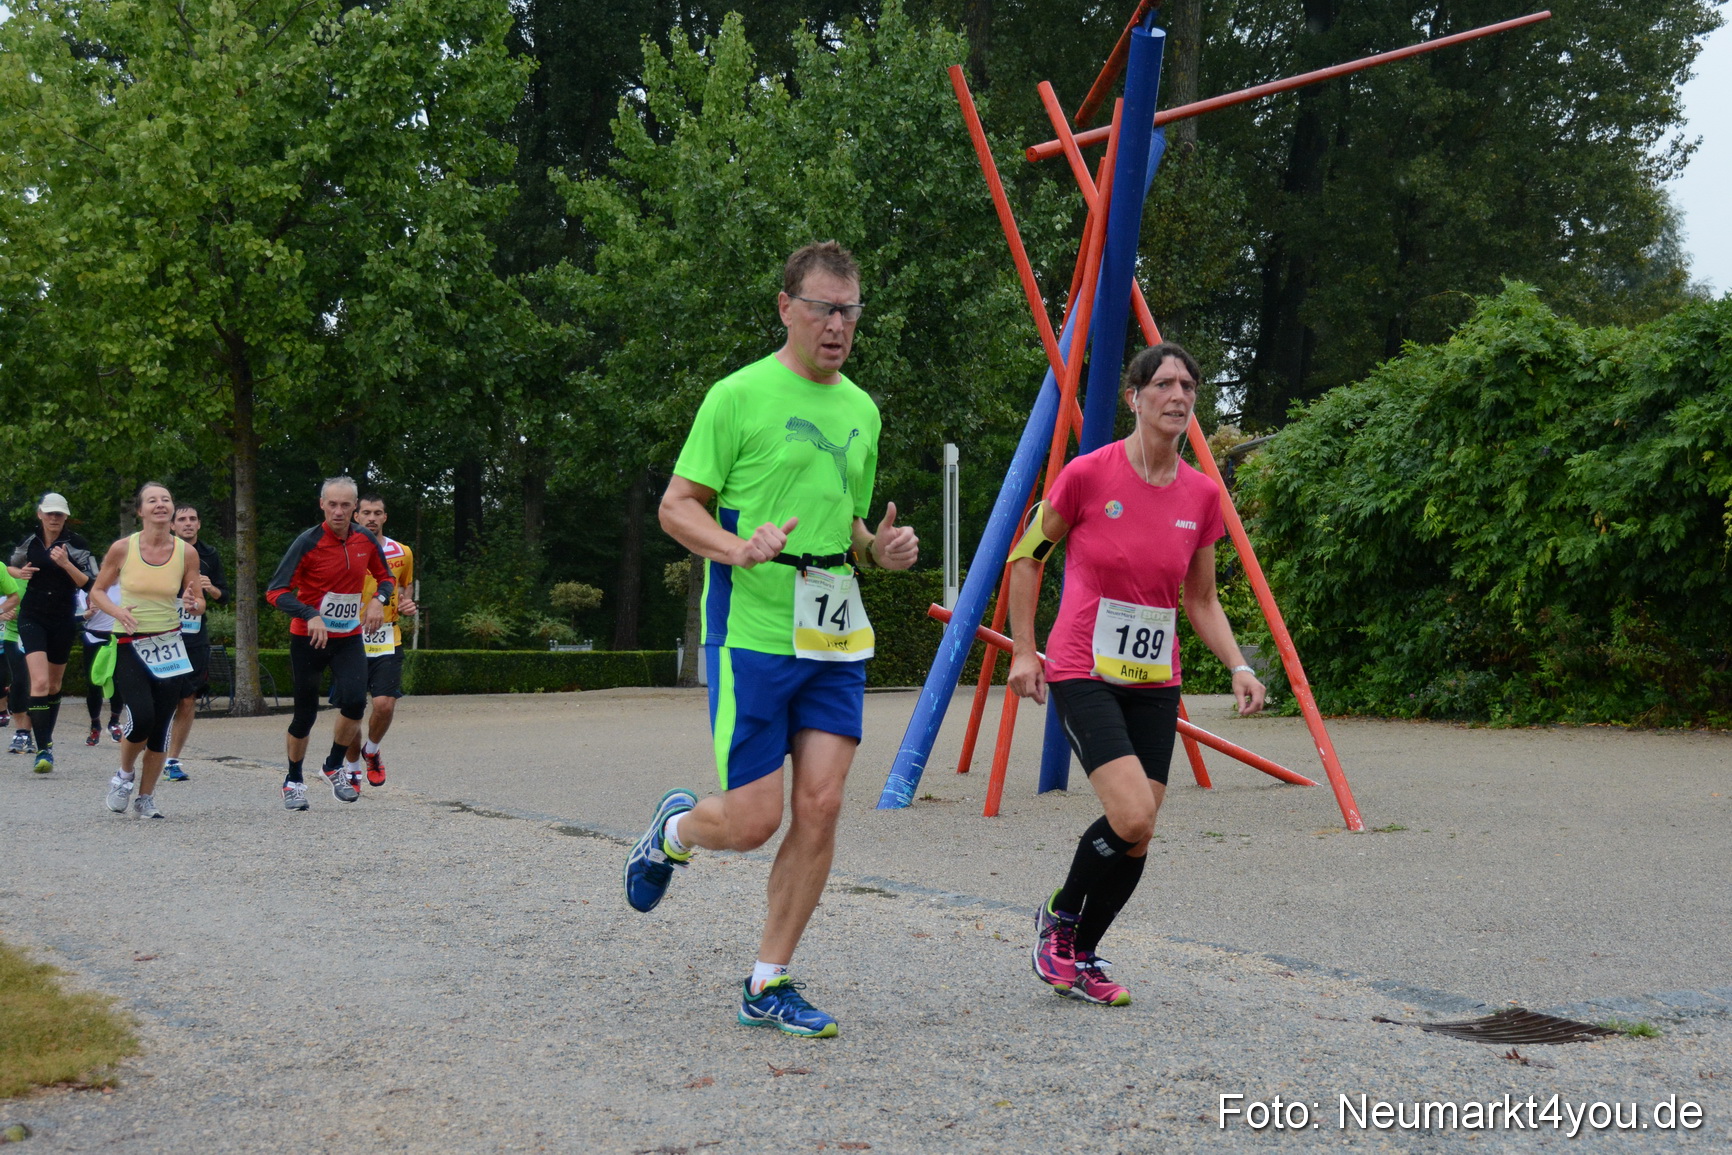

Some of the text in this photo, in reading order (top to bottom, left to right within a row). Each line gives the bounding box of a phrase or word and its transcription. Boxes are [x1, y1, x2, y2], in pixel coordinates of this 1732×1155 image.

[1174, 519, 1197, 531] ANITA
[324, 602, 358, 618] 2099
[1115, 624, 1165, 660] 189
[141, 642, 181, 664] 2131
[1120, 664, 1149, 680] Anita
